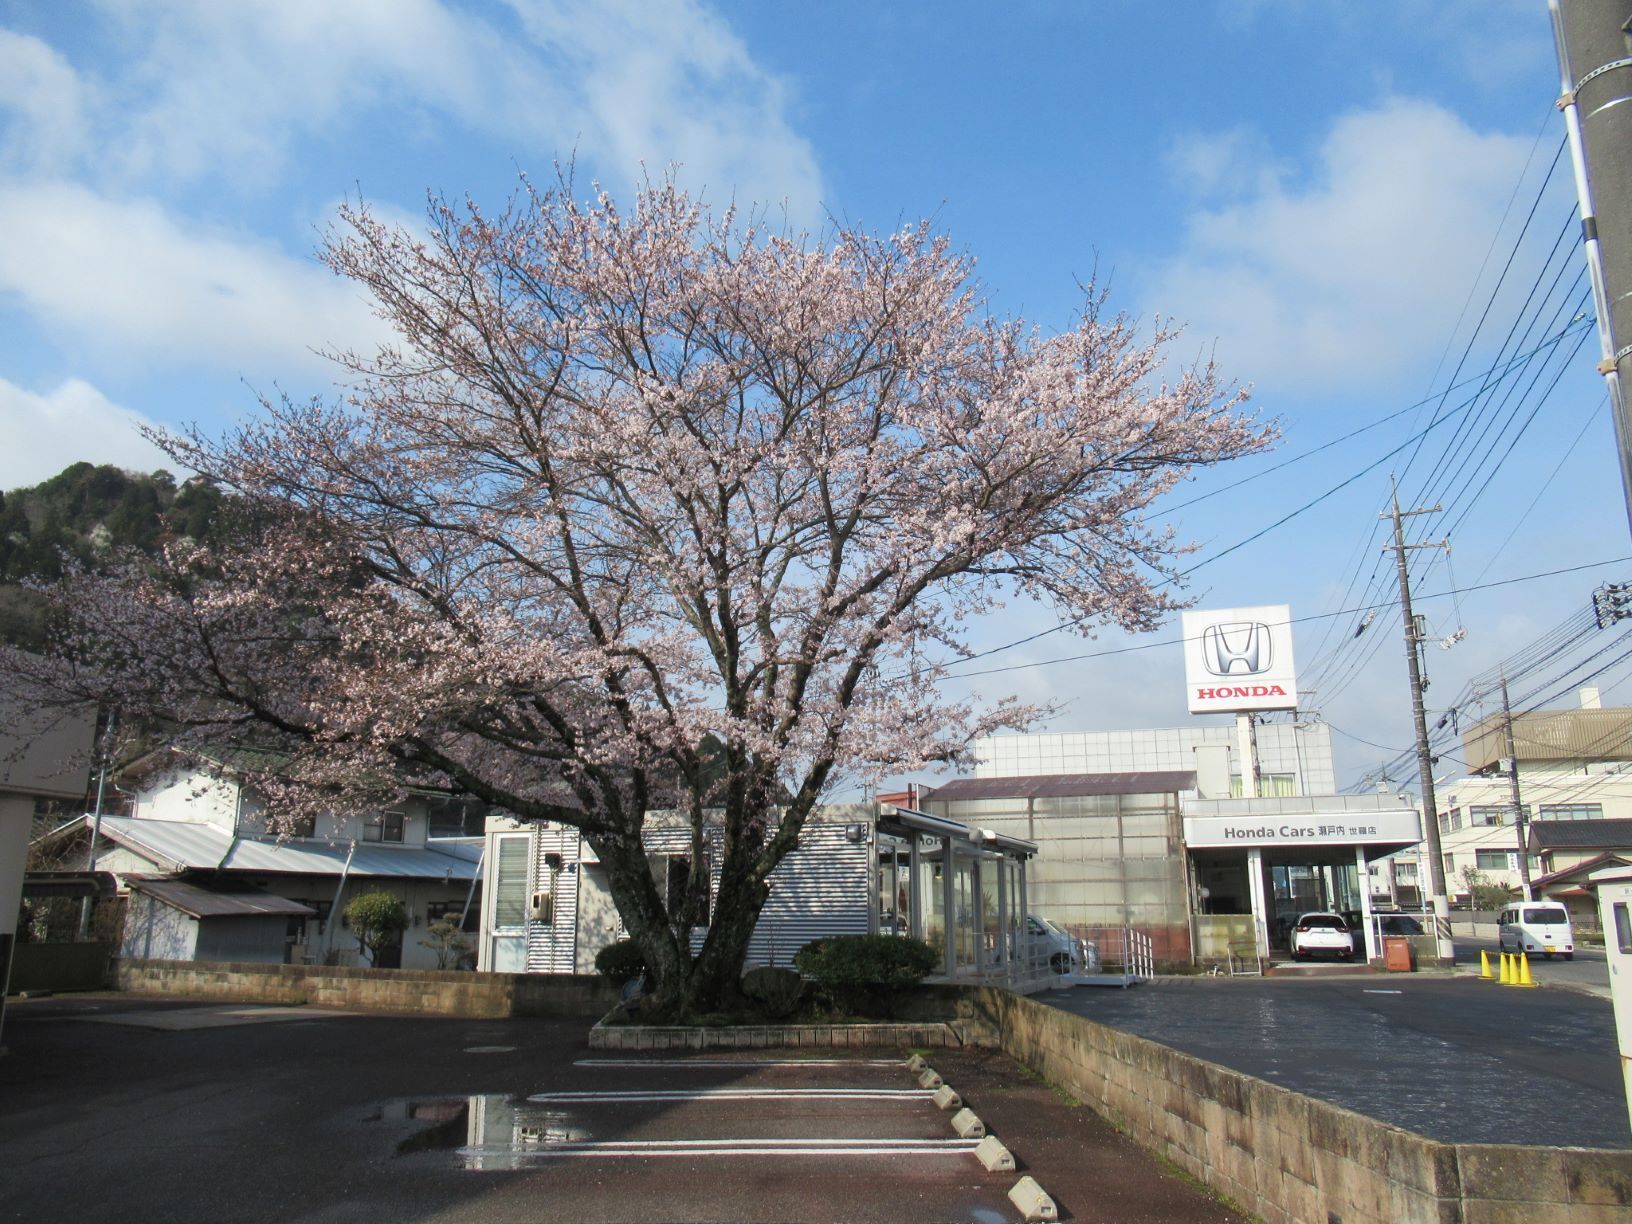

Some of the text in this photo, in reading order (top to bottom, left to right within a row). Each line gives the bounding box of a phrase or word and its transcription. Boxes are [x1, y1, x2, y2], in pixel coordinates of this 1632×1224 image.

[1197, 685, 1287, 699] HONDA
[1224, 826, 1275, 838] Honda
[1279, 825, 1315, 837] Cars
